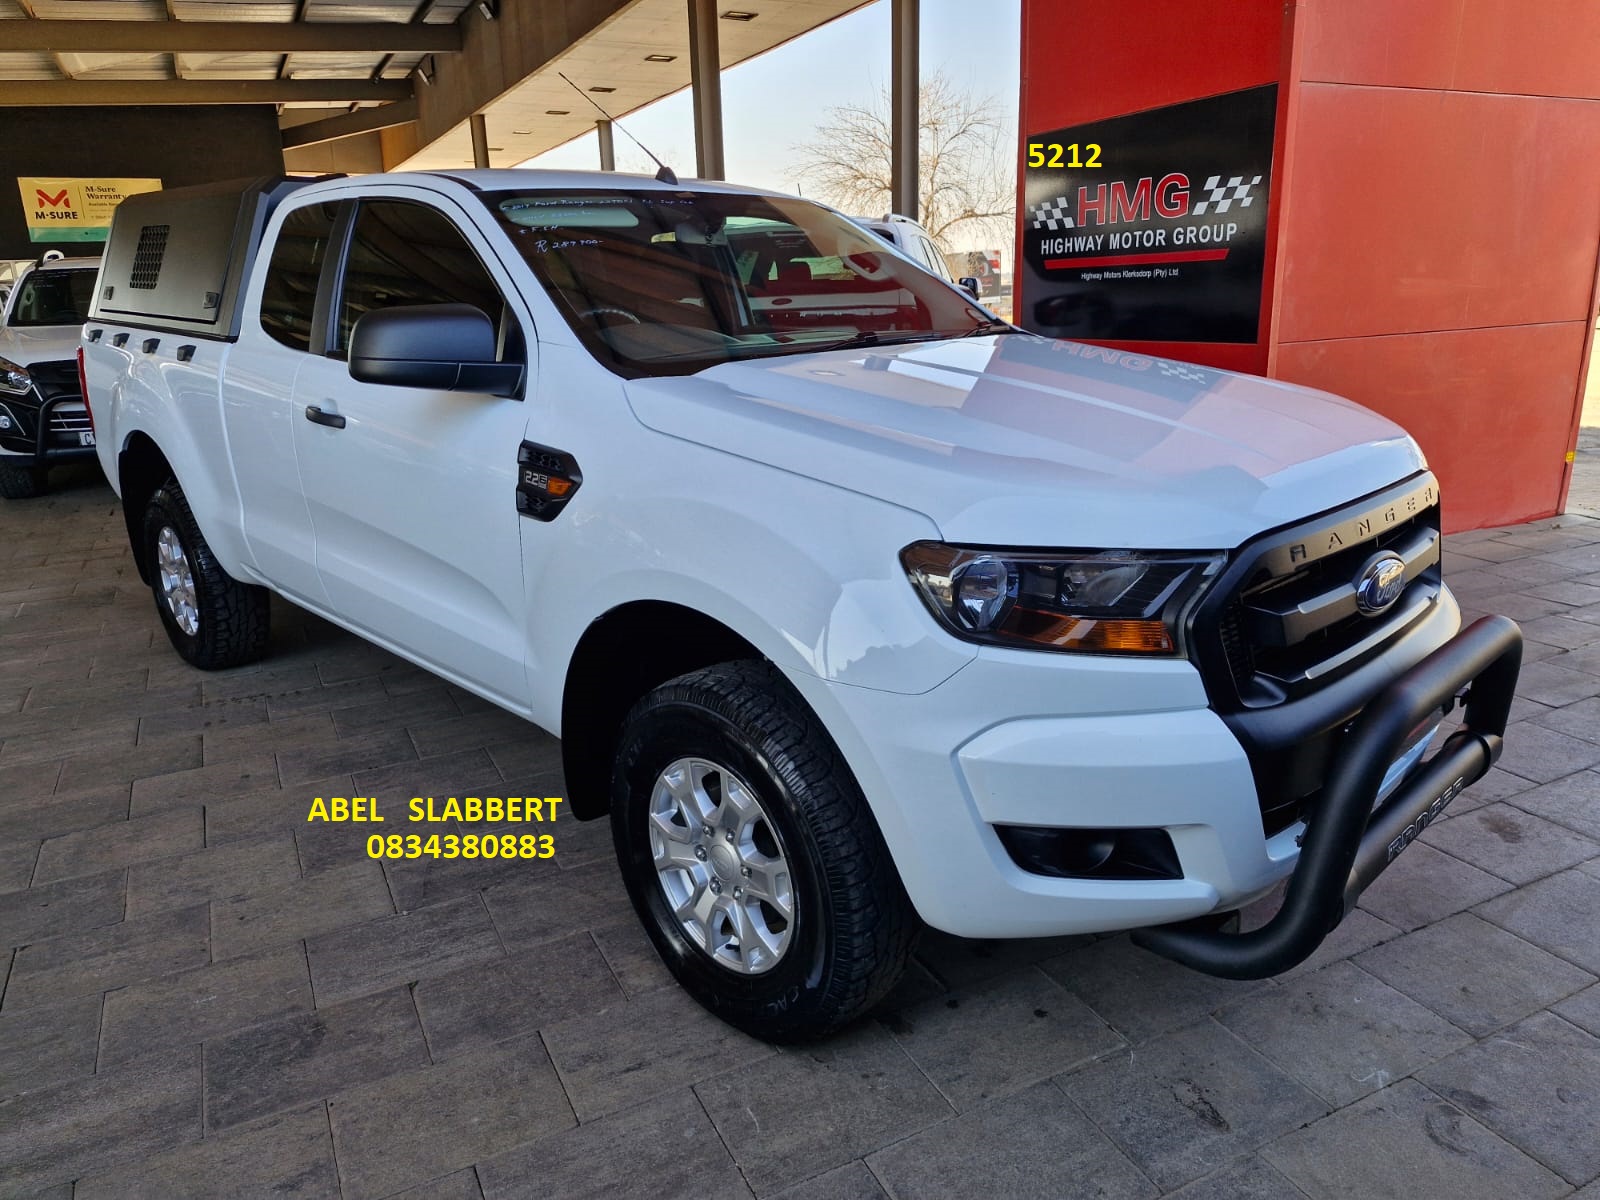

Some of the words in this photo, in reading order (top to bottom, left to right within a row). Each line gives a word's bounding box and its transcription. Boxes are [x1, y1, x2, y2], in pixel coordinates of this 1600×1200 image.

[86, 193, 127, 201] Warranty
[1077, 172, 1190, 228] HMG
[1041, 234, 1105, 255] HIGHWAY
[1109, 229, 1166, 250] MOTOR
[1173, 222, 1238, 245] GROUP
[1081, 272, 1102, 281] Highway
[1168, 267, 1179, 276] Ltd
[1289, 487, 1432, 563] RANGER
